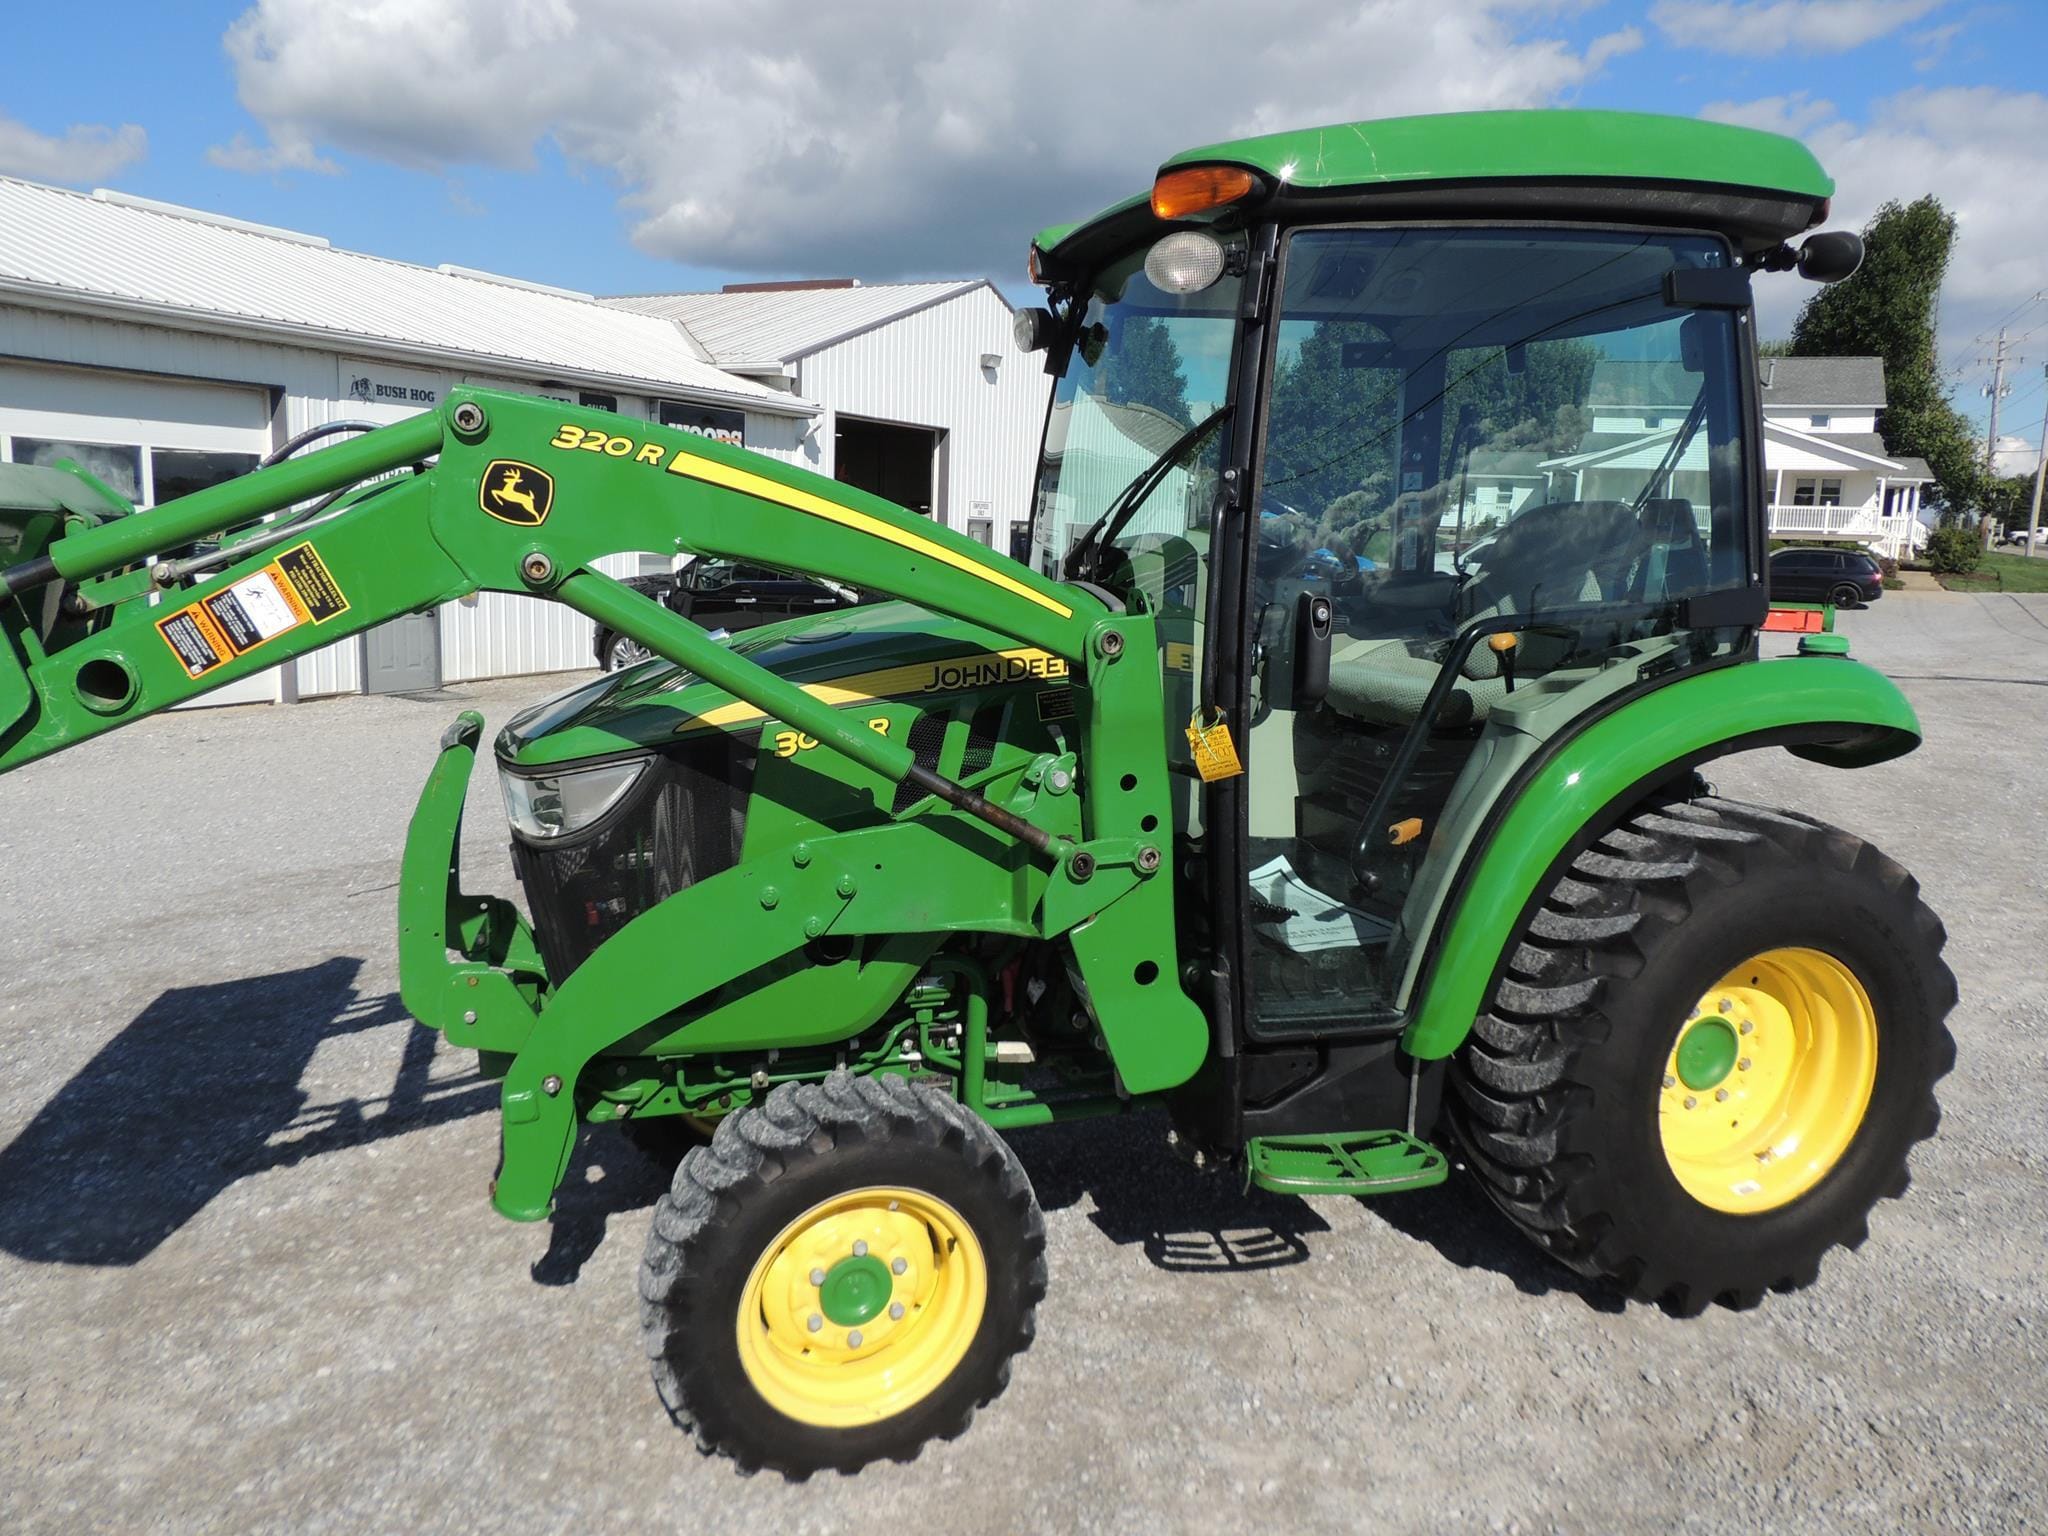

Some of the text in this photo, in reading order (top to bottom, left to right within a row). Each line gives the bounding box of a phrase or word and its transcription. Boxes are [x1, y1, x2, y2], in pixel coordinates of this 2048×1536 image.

[376, 384, 435, 402] BUSH HOG
[549, 424, 666, 466] 320 R
[278, 581, 303, 617] WARNING
[200, 620, 226, 656] WARNING
[924, 662, 1000, 691] JOHN
